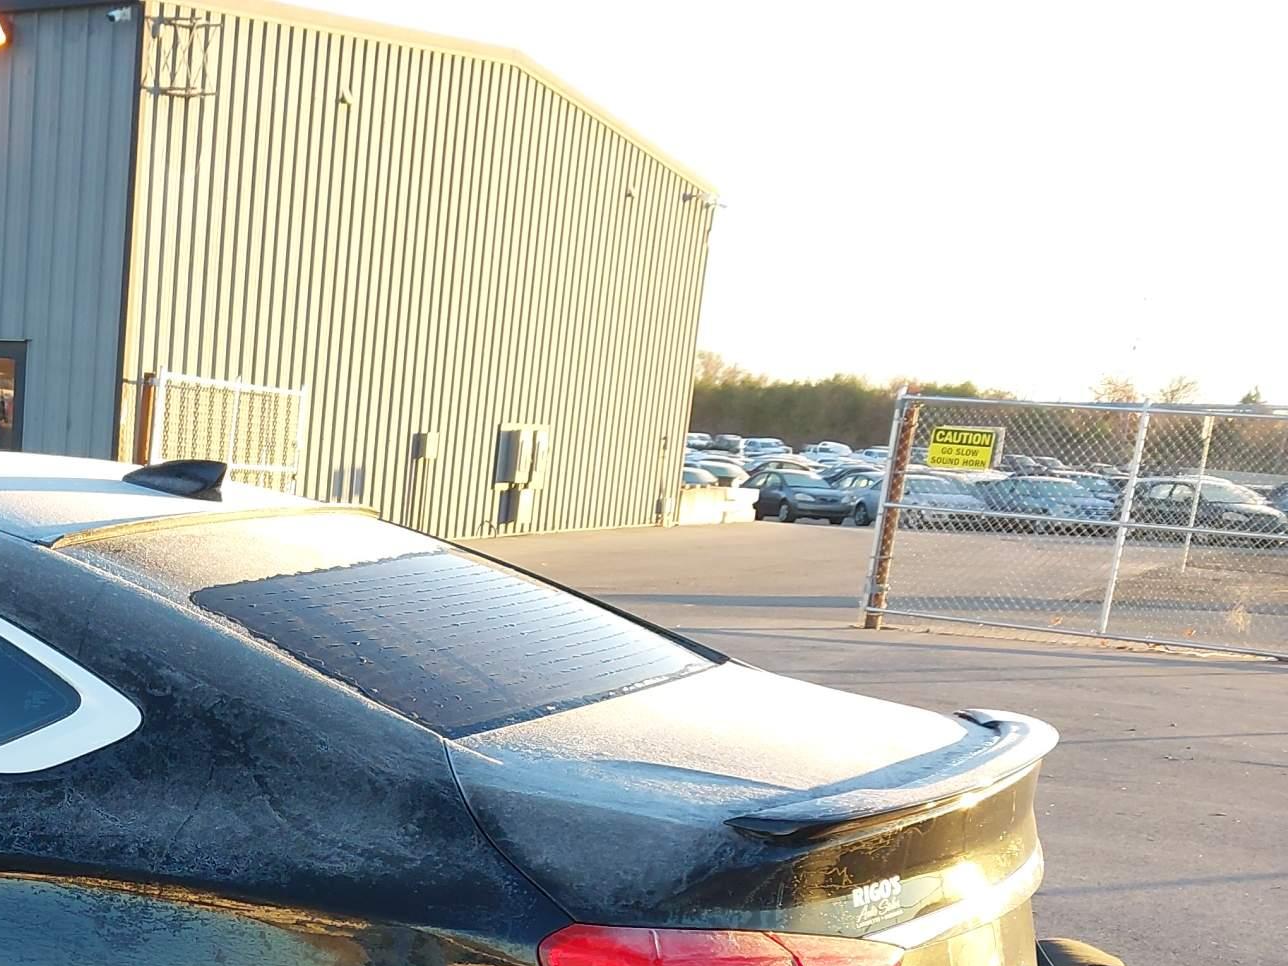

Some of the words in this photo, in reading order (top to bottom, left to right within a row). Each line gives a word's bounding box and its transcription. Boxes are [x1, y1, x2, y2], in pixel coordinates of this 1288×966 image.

[935, 430, 992, 446] CAUTION
[941, 447, 953, 455] GO
[955, 448, 979, 457] SLOW
[930, 456, 960, 466] SOUND
[961, 459, 987, 467] HORN
